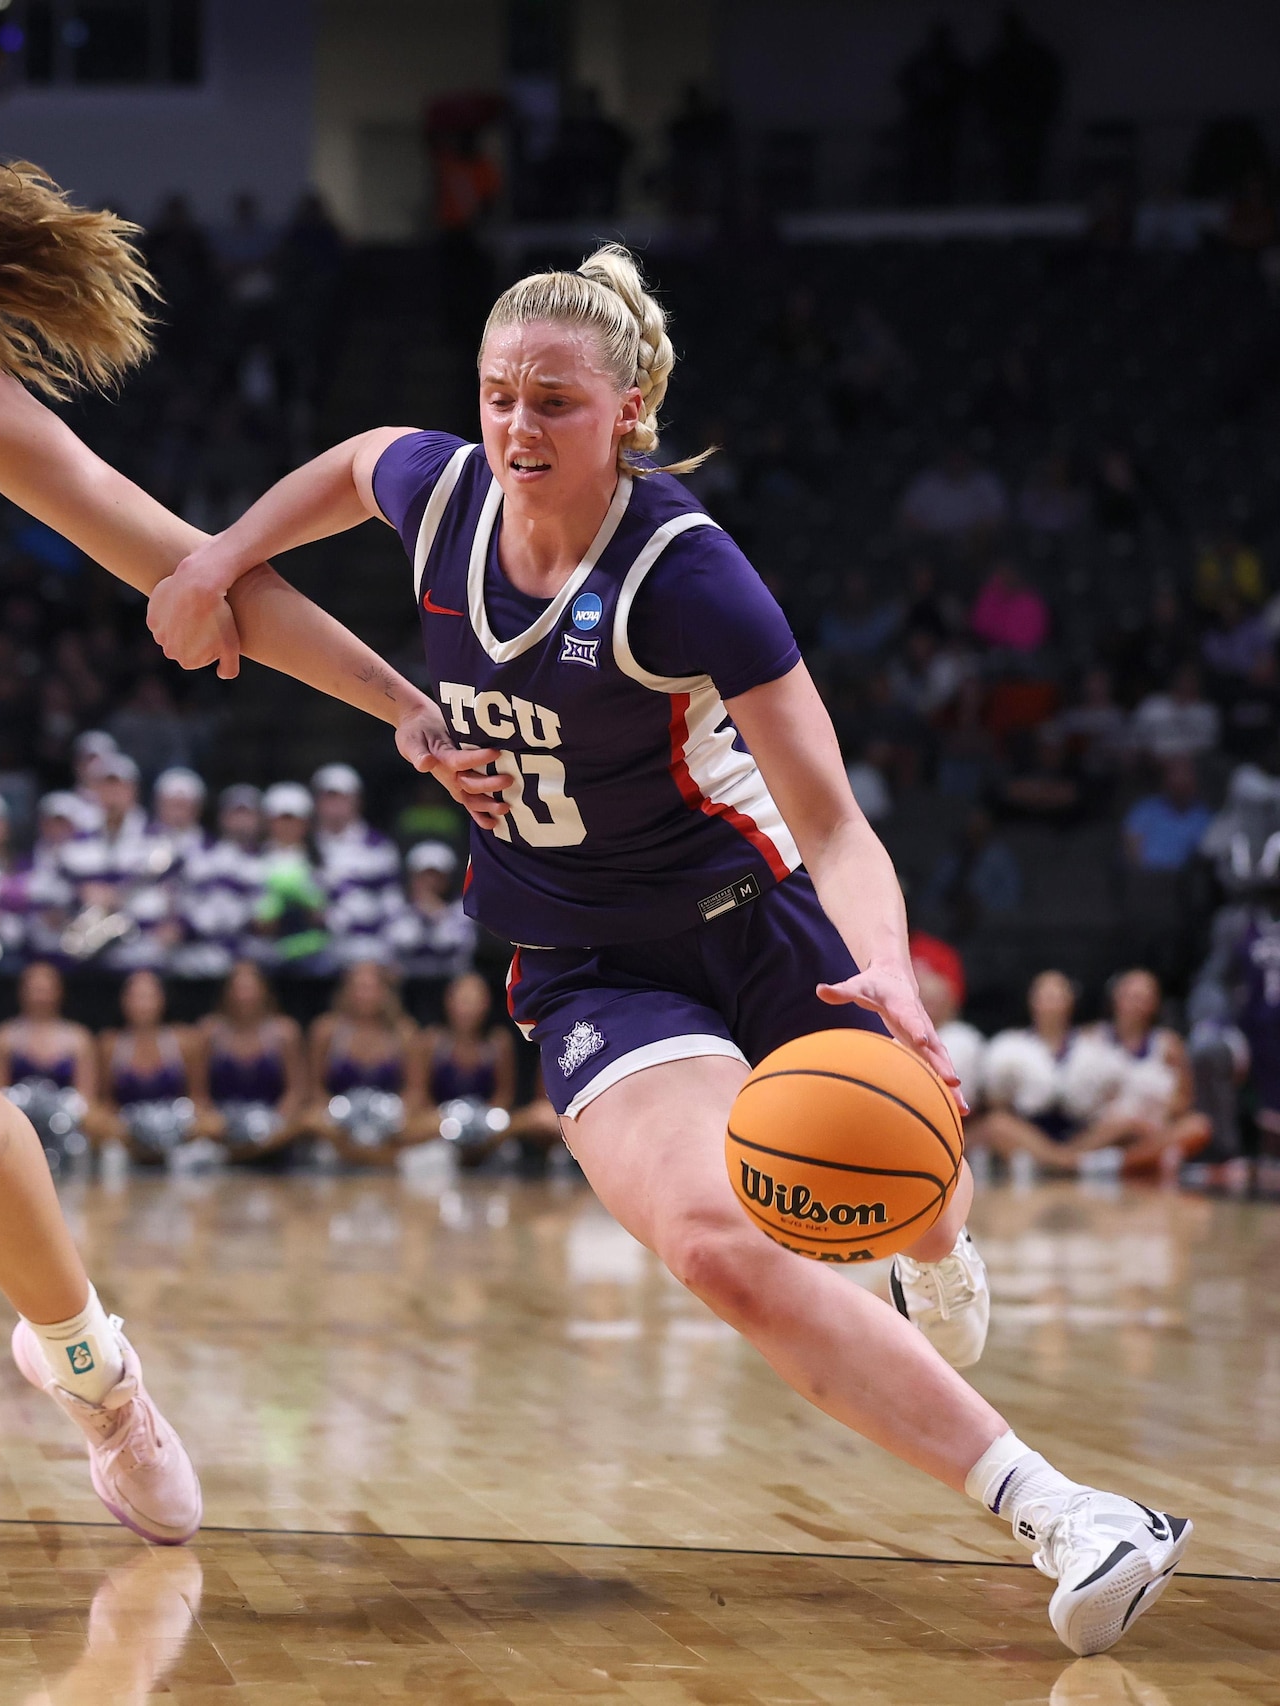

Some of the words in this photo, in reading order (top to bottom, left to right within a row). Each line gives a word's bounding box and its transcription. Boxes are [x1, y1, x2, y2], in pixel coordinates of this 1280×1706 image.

[575, 610, 601, 622] NCAA
[439, 681, 563, 750] TCU
[739, 883, 753, 898] M
[740, 1158, 888, 1227] Wilson
